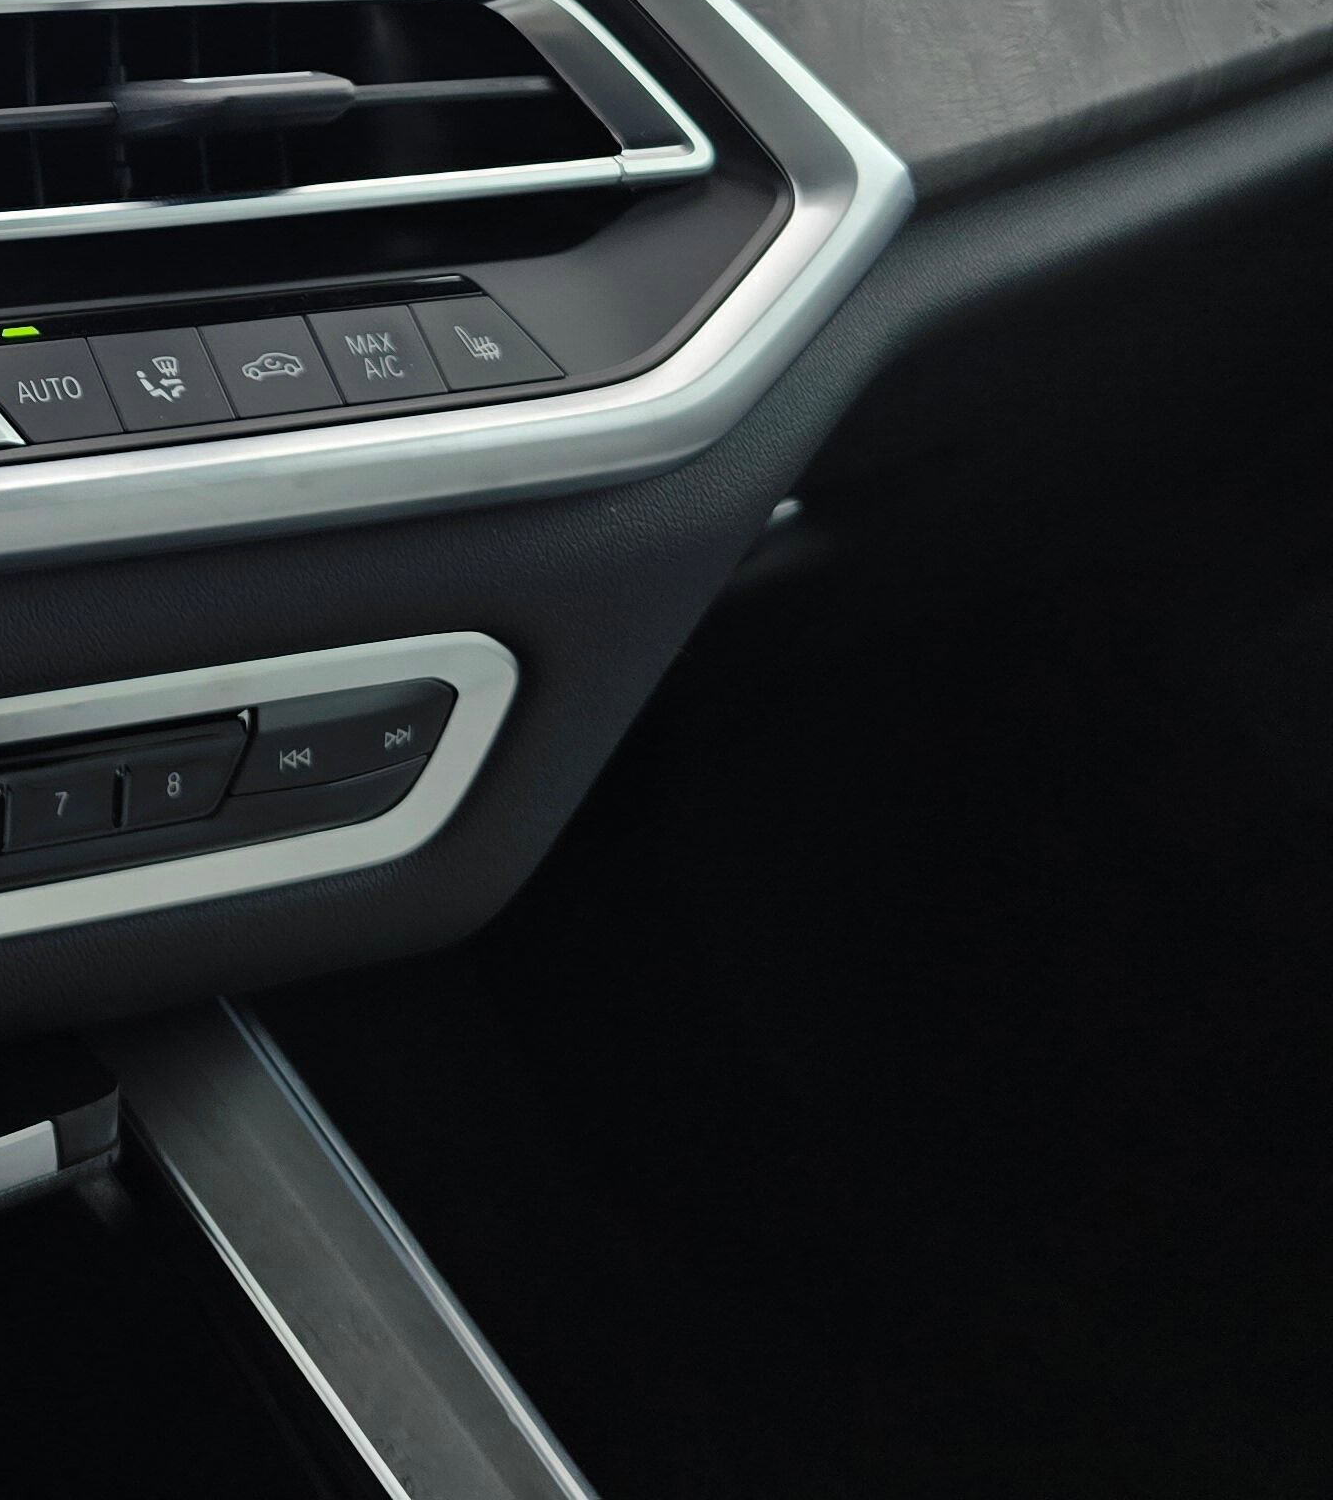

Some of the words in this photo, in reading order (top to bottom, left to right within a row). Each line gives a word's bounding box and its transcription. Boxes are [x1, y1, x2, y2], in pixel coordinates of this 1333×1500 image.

[345, 332, 397, 357] MAX
[364, 354, 404, 380] A/C
[16, 375, 83, 403] AUTO
[166, 771, 182, 797] 8
[54, 790, 70, 817] 7
